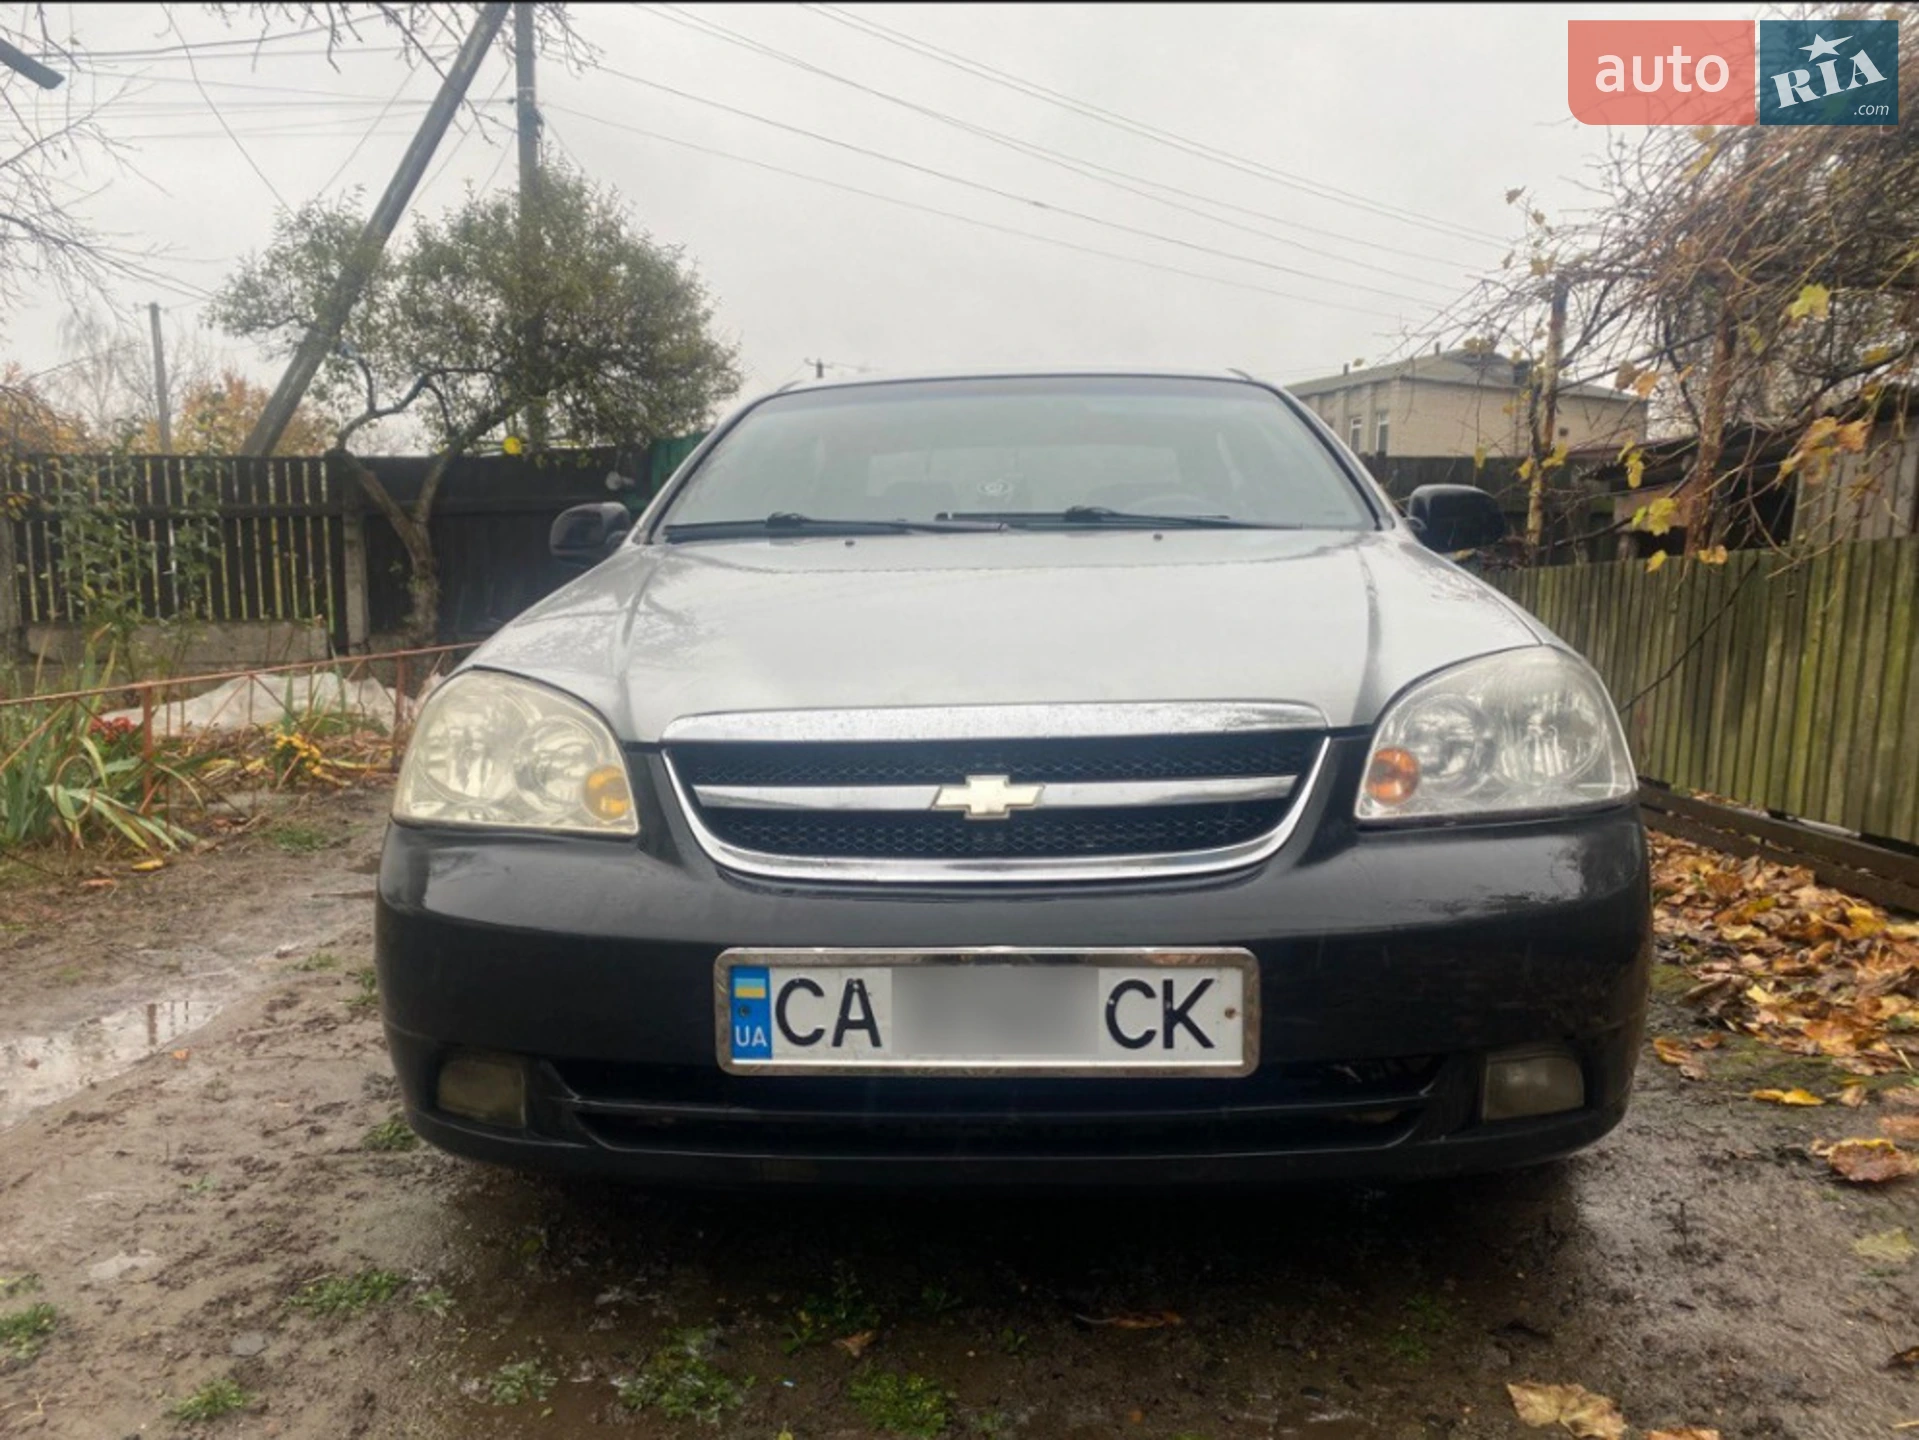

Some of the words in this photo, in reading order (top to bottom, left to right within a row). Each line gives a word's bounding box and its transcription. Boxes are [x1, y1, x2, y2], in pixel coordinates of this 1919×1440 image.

[774, 978, 882, 1047] CA
[1105, 979, 1215, 1049] CK
[735, 1026, 767, 1048] UA
